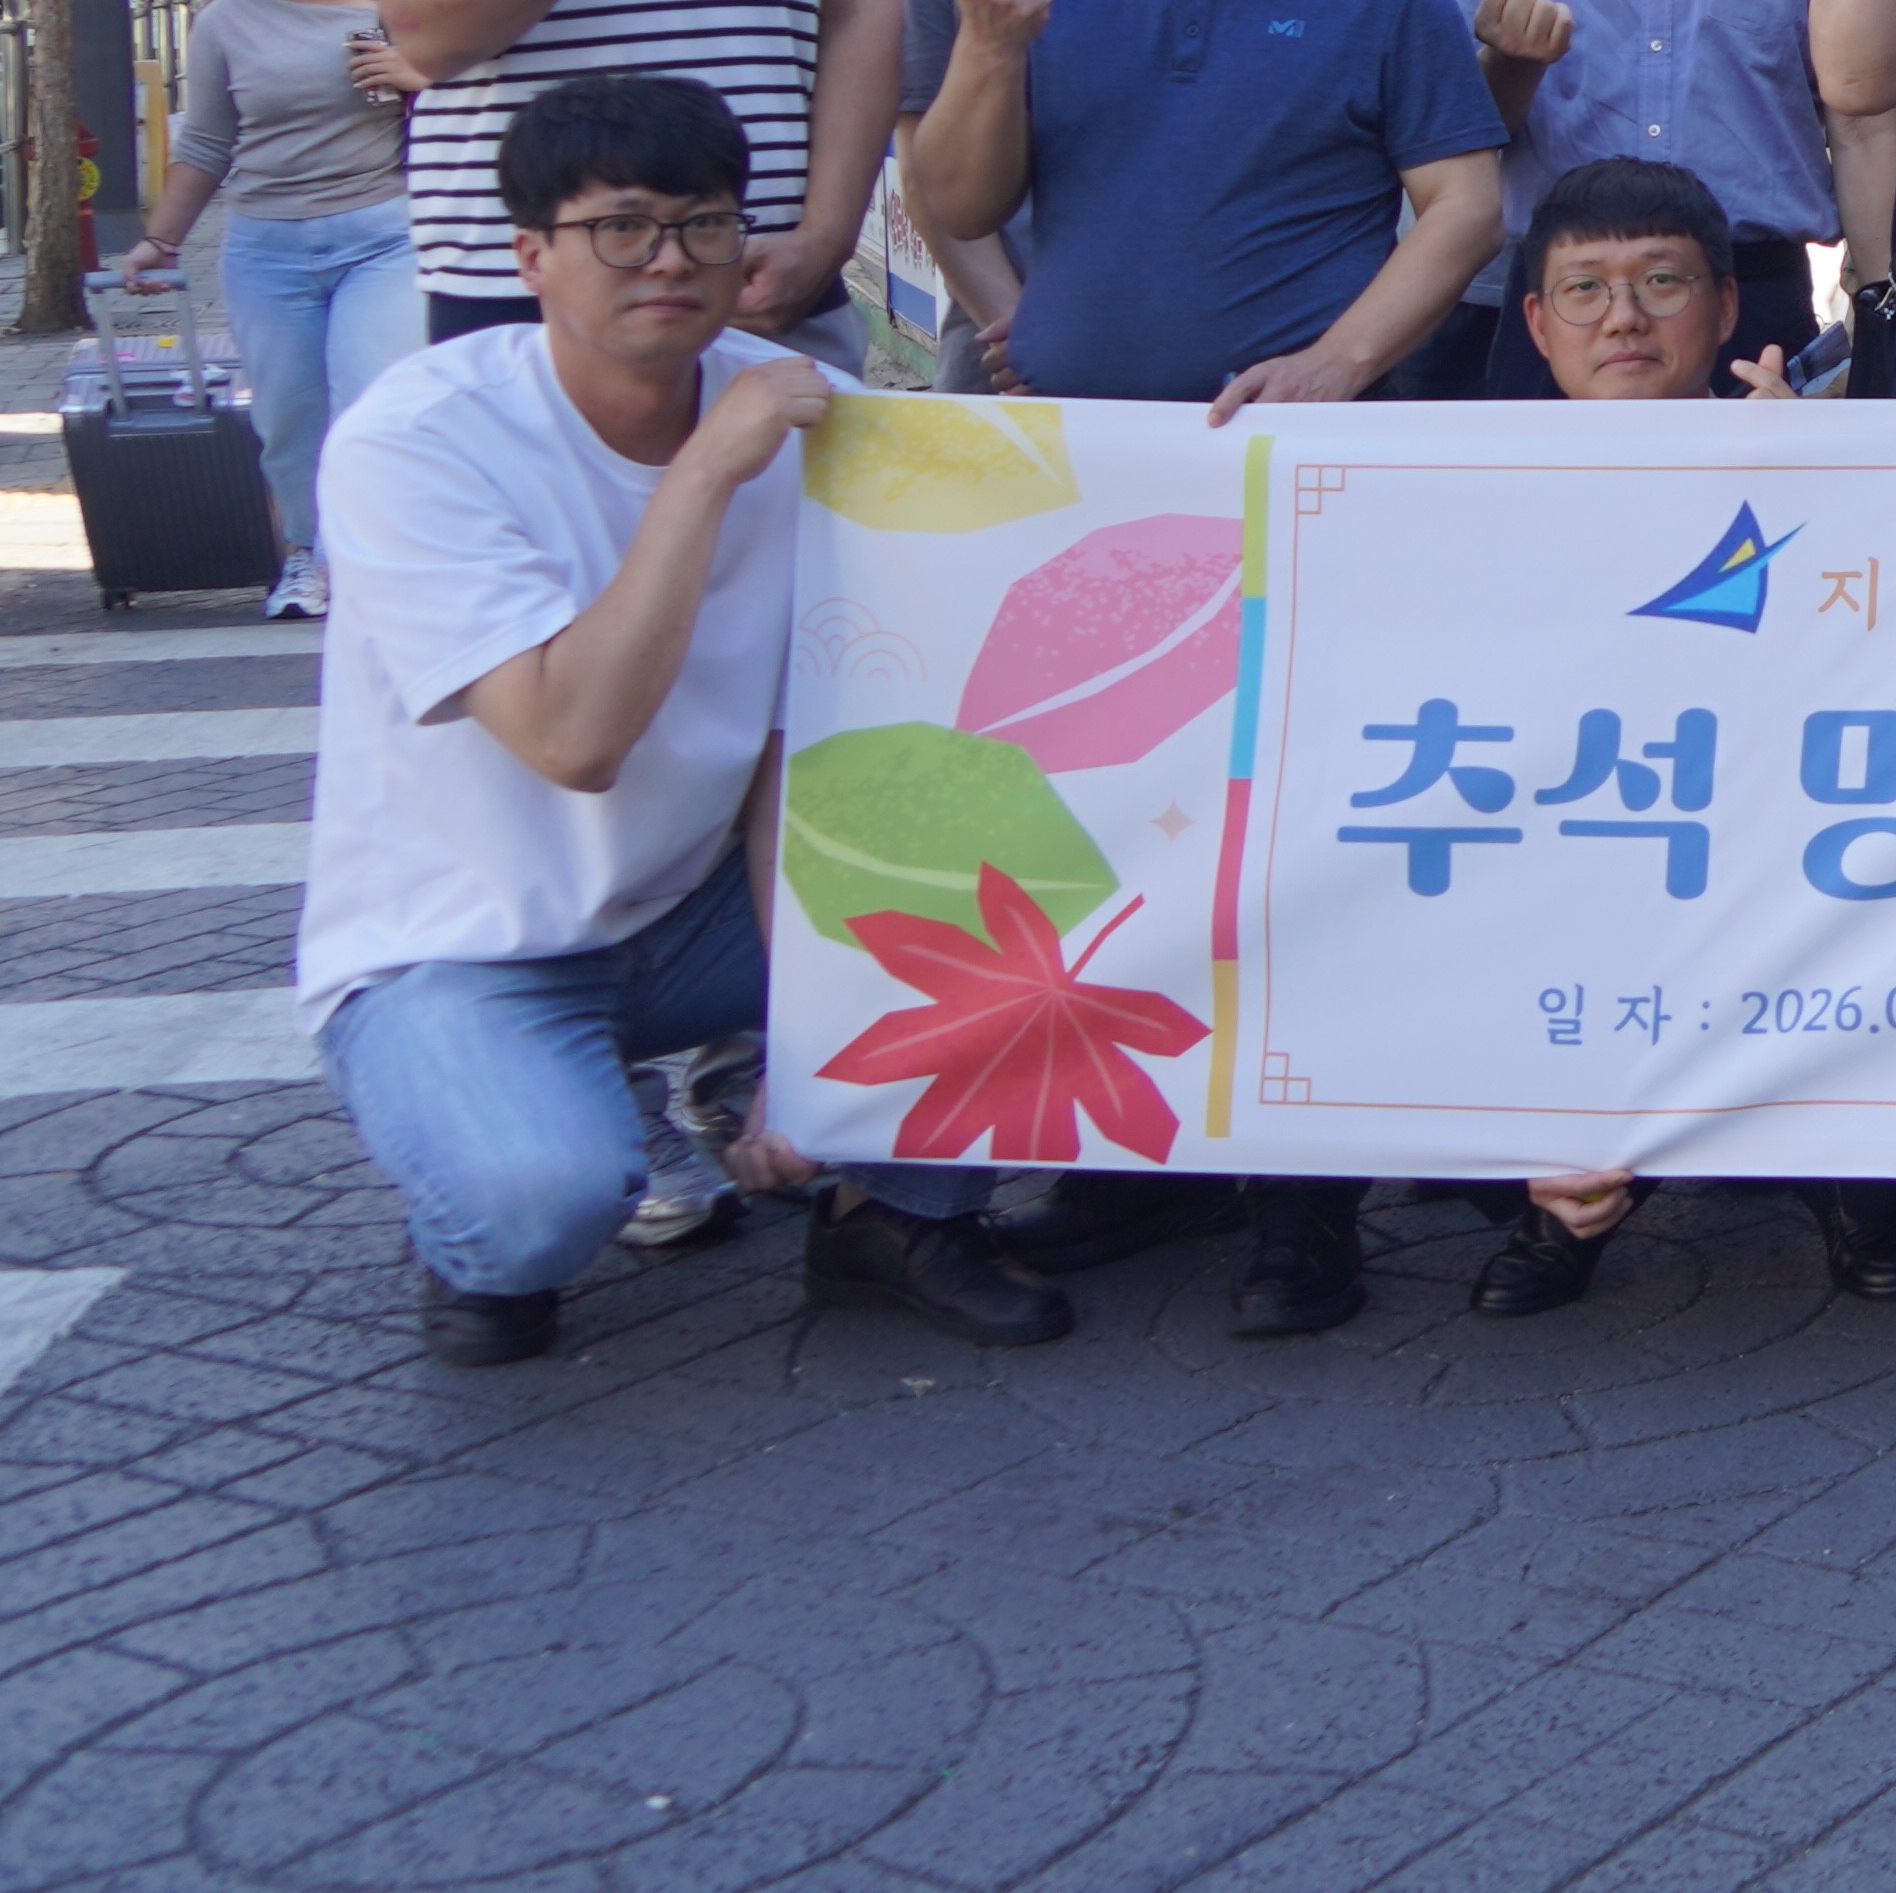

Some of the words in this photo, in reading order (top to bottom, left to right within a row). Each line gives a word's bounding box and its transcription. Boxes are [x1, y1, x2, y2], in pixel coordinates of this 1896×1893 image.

[1335, 697, 1720, 903] 추석
[1536, 983, 1588, 1048] 일
[1614, 983, 1673, 1048] 자
